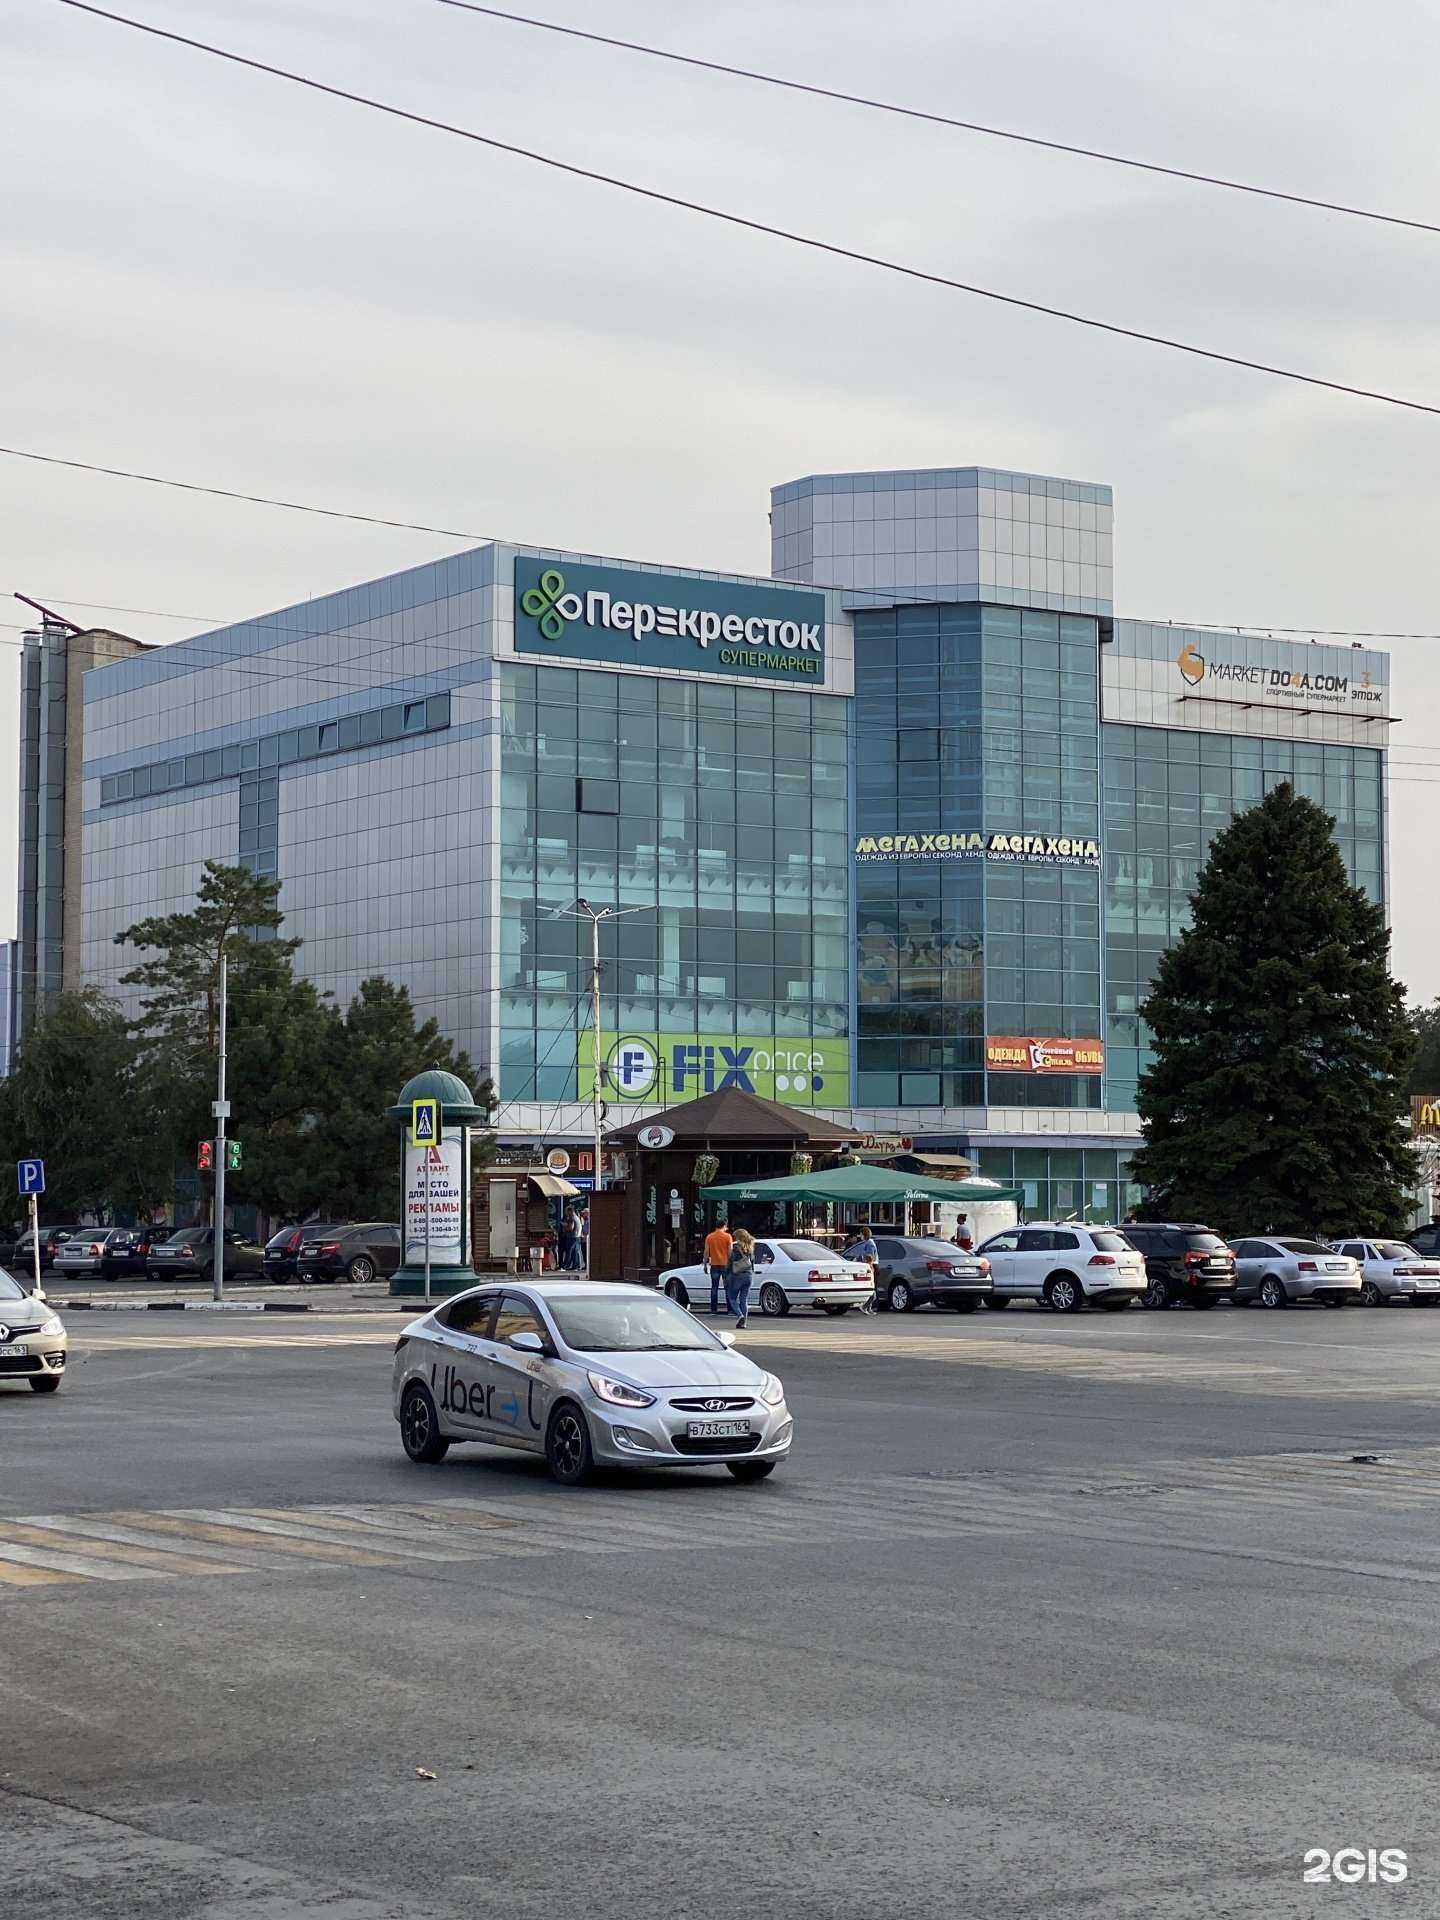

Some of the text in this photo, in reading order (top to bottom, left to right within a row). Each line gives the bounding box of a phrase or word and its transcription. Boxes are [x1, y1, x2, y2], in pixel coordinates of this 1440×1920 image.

[720, 649, 822, 673] СУПЕРМАРКЕТ
[1361, 671, 1373, 689] 3
[1306, 692, 1346, 703] СУПЕРМАРКЕТ
[855, 850, 984, 862] ОДЕЖДА ИЗ ЕВРОПЫ СЕКОНД ХЕНД
[987, 851, 1015, 860] ОДЕЖДА
[1016, 853, 1025, 861] ИЗ
[1028, 854, 1054, 862] ЕВРОПЫ
[1055, 857, 1080, 865] СЕКОНД
[987, 1048, 1027, 1062] ОДЕЖДА
[1075, 1050, 1104, 1064] ОБУВЬ
[24, 1163, 38, 1191] P
[408, 1190, 425, 1199] ДЛЯ
